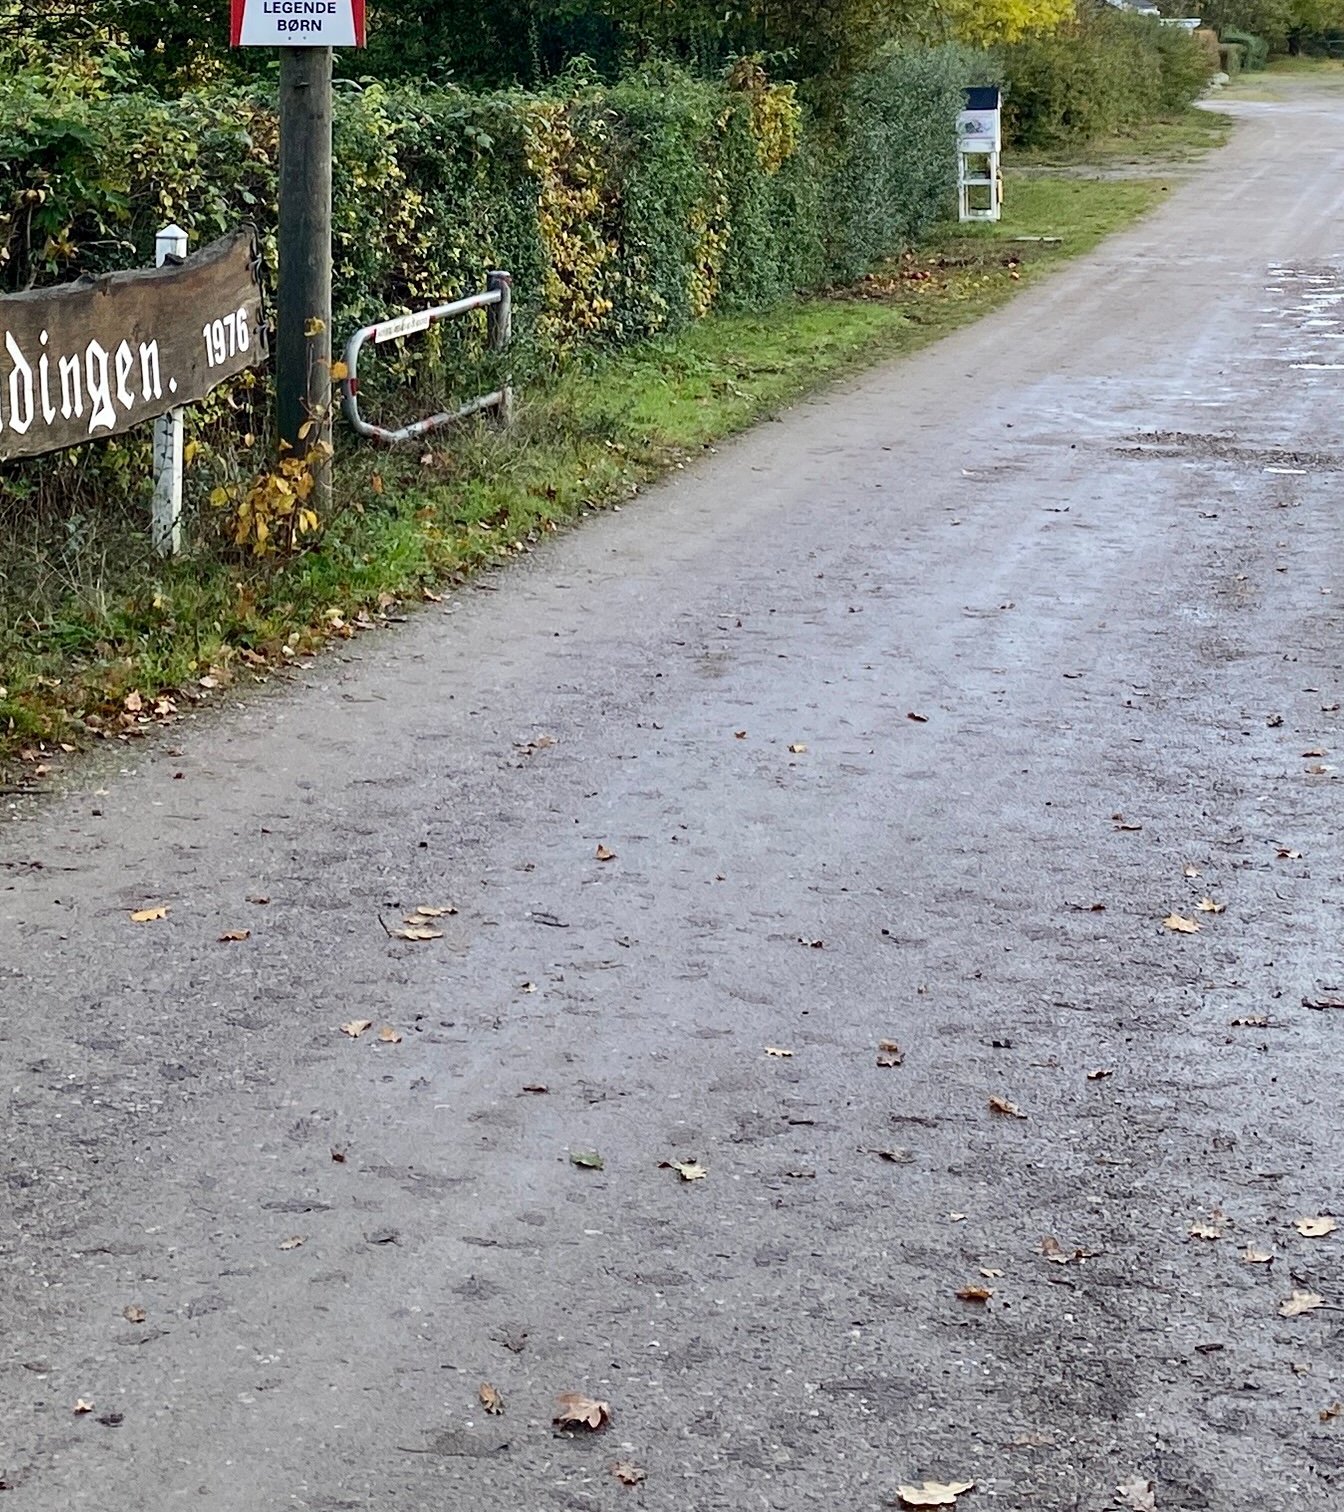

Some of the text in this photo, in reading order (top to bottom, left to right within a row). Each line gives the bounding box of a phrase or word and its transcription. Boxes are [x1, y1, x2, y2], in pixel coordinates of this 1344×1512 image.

[263, 1, 336, 14] LEGENDE
[277, 19, 322, 32] BØRN
[202, 307, 250, 368] 1976
